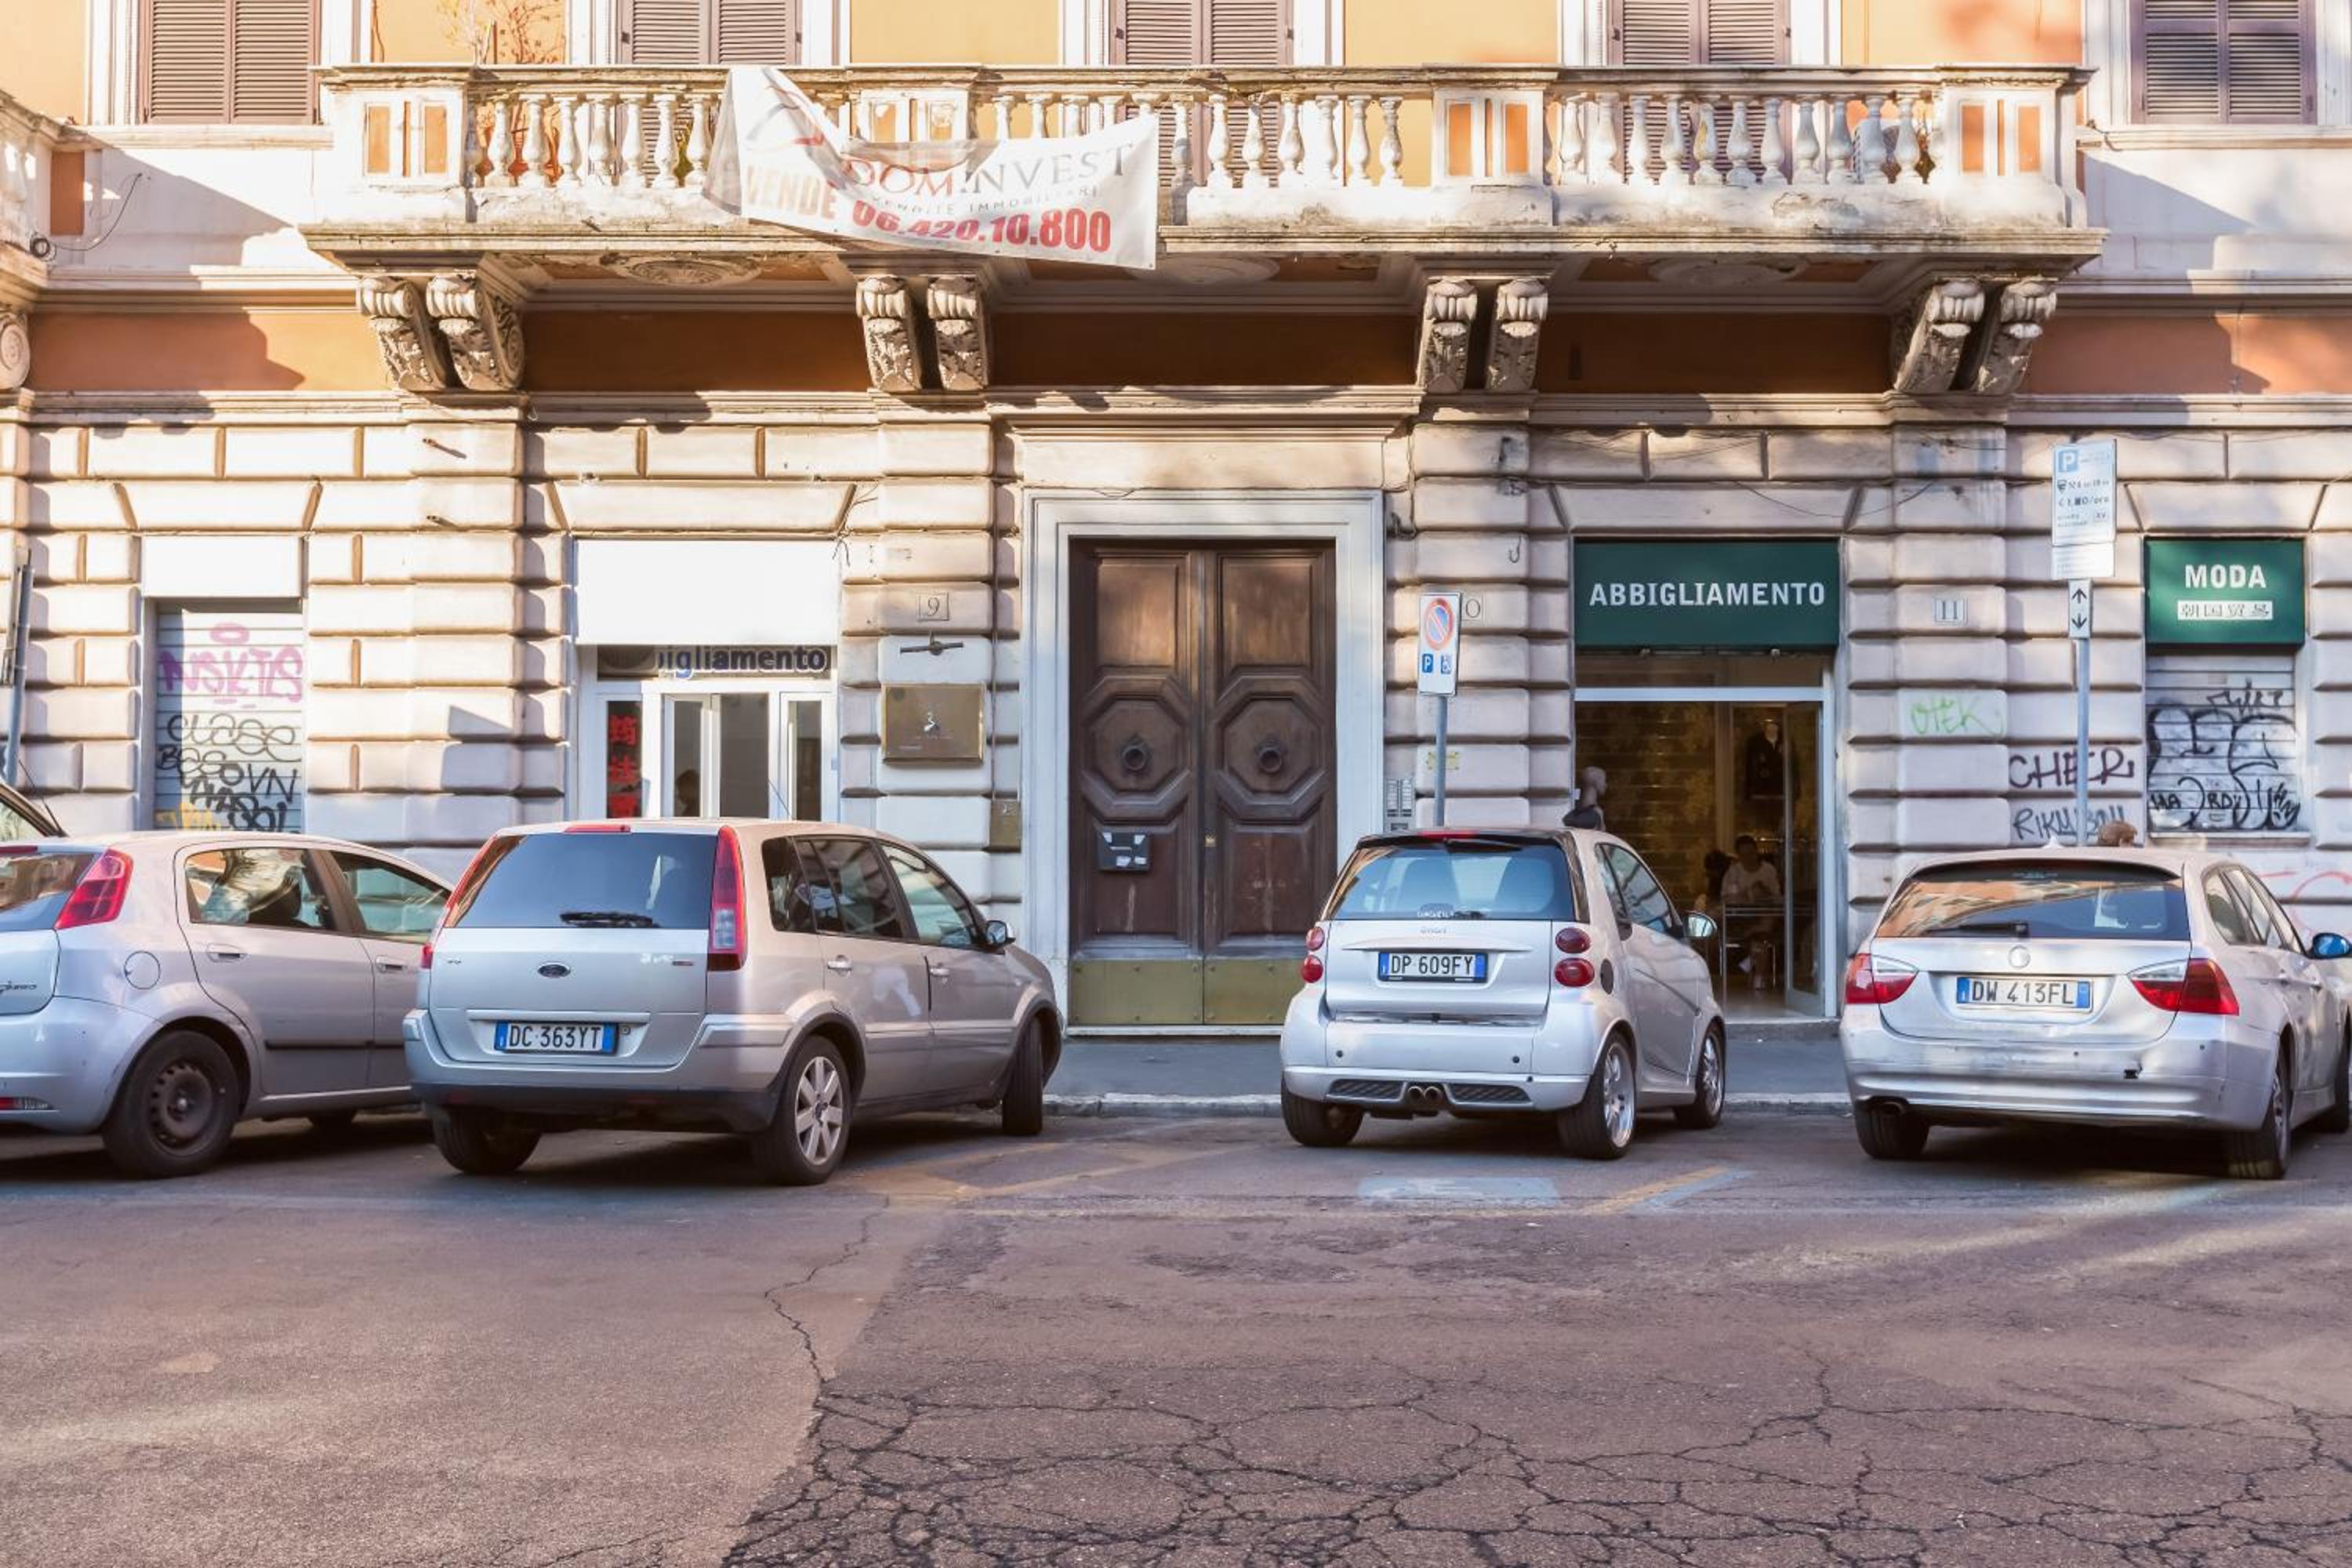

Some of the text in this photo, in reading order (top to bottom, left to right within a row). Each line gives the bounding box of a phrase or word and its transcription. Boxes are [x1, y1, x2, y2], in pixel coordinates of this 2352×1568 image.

[2184, 564, 2267, 589] MODA
[1589, 582, 1825, 606] ABBIGLIAMENTO
[927, 597, 940, 617] 9
[657, 644, 826, 679] igliamento
[1392, 956, 1412, 974] DP
[1418, 956, 1474, 975] 609FY
[1972, 981, 1998, 1002] DW
[2007, 982, 2074, 1004] 413FL
[510, 1025, 534, 1047] DC
[539, 1025, 601, 1049] 363YT
